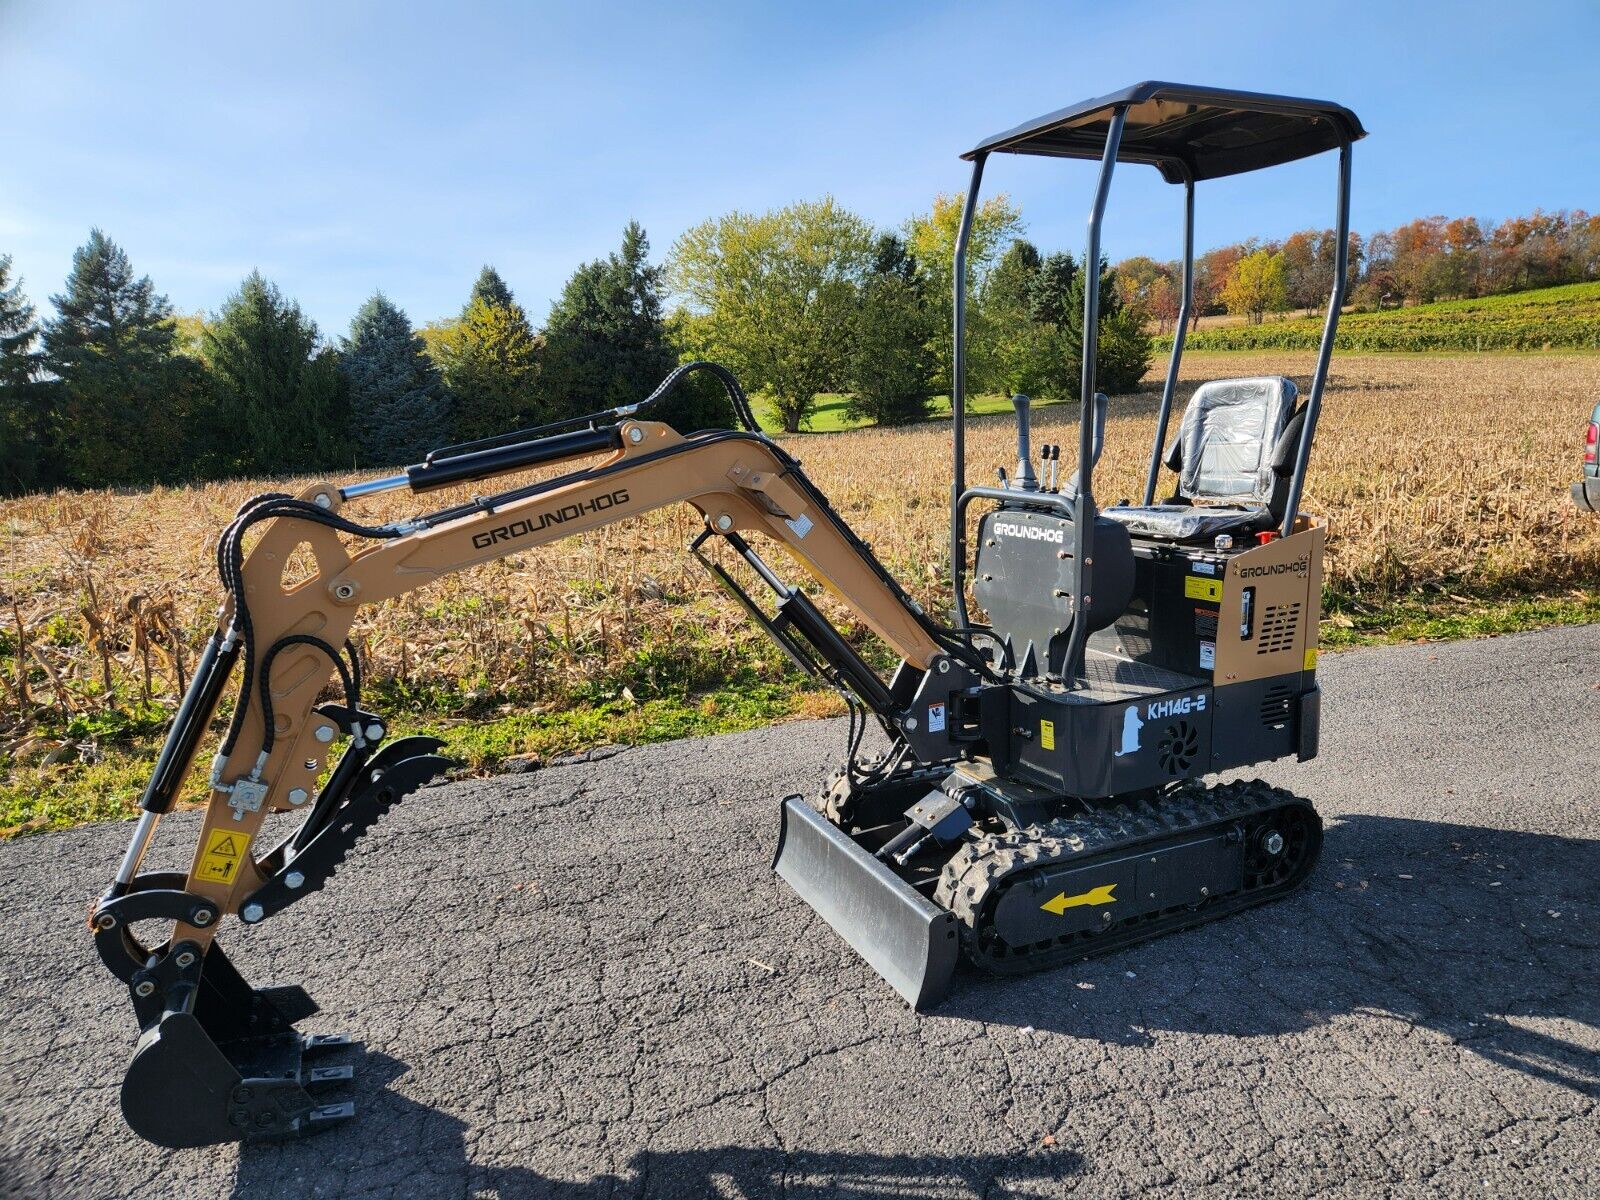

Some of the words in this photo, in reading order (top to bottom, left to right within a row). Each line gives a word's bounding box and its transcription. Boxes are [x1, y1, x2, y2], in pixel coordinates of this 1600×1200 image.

[472, 489, 630, 549] GROUNDHOG
[993, 522, 1064, 544] GROUNDHOG
[1240, 561, 1307, 579] GROUNDHOG
[1147, 694, 1206, 720] KH14G-2
